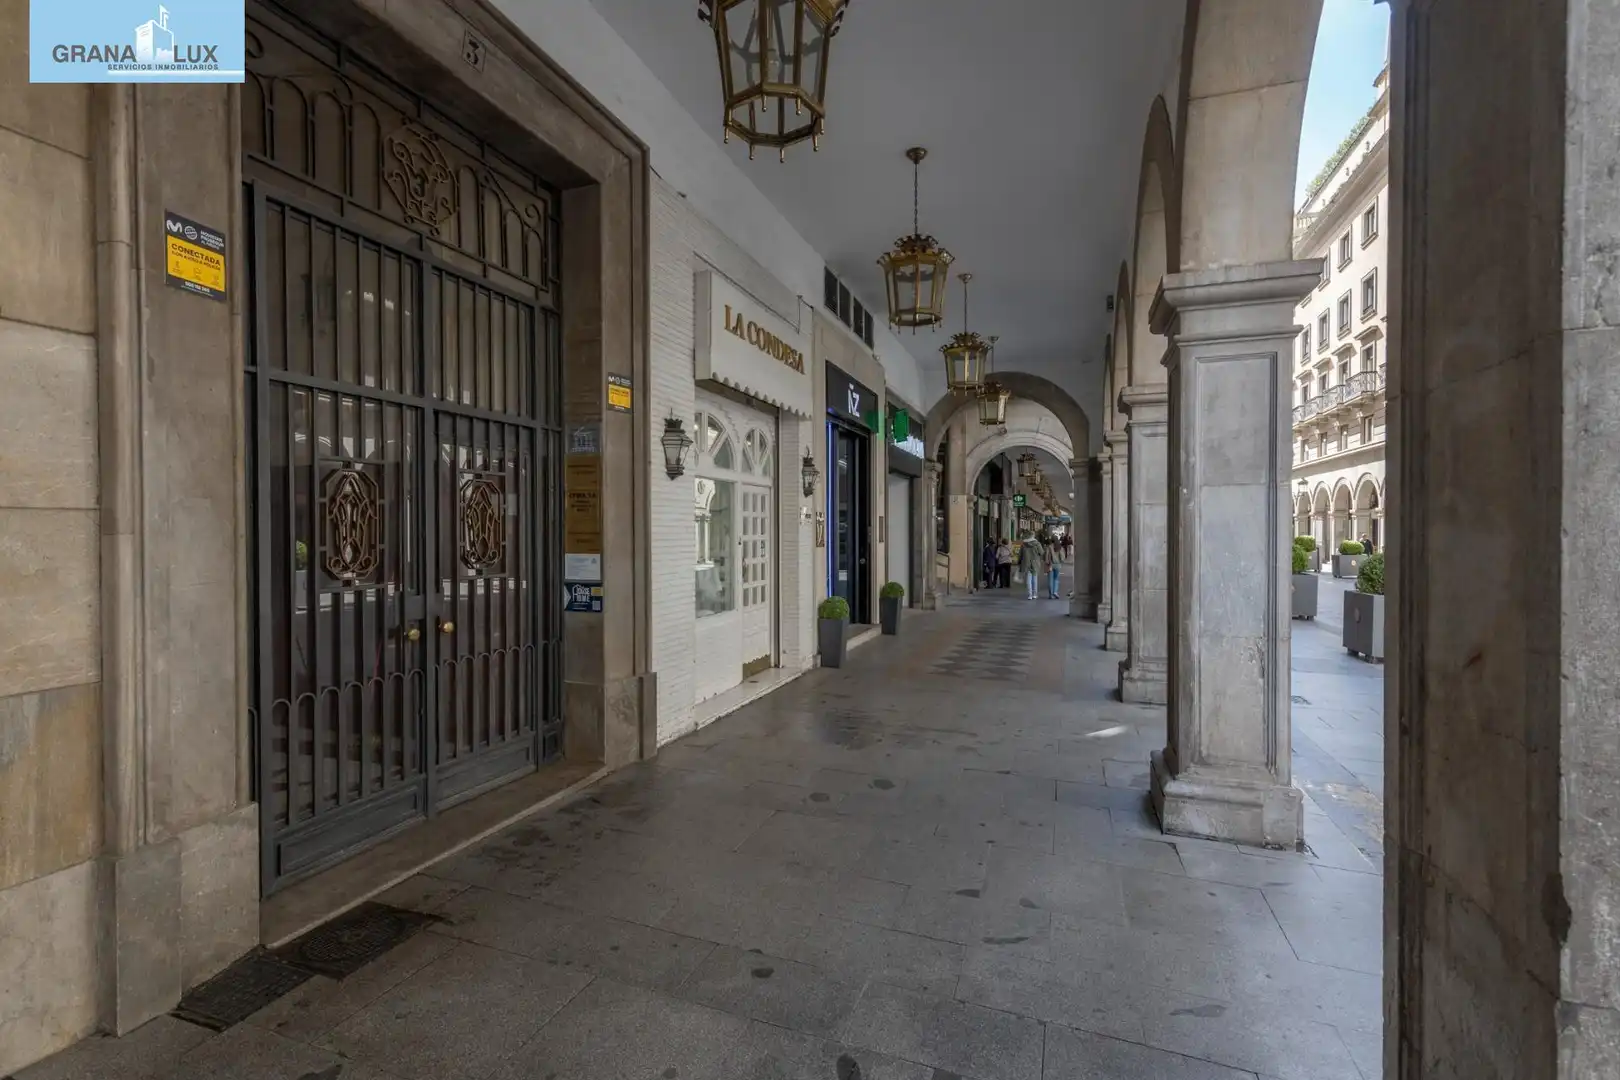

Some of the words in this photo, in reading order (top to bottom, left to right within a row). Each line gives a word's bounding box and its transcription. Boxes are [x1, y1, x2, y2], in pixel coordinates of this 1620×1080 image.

[466, 39, 480, 66] 3
[171, 243, 221, 266] CONECTADA
[724, 304, 746, 341] LA
[747, 320, 806, 375] CONDESA
